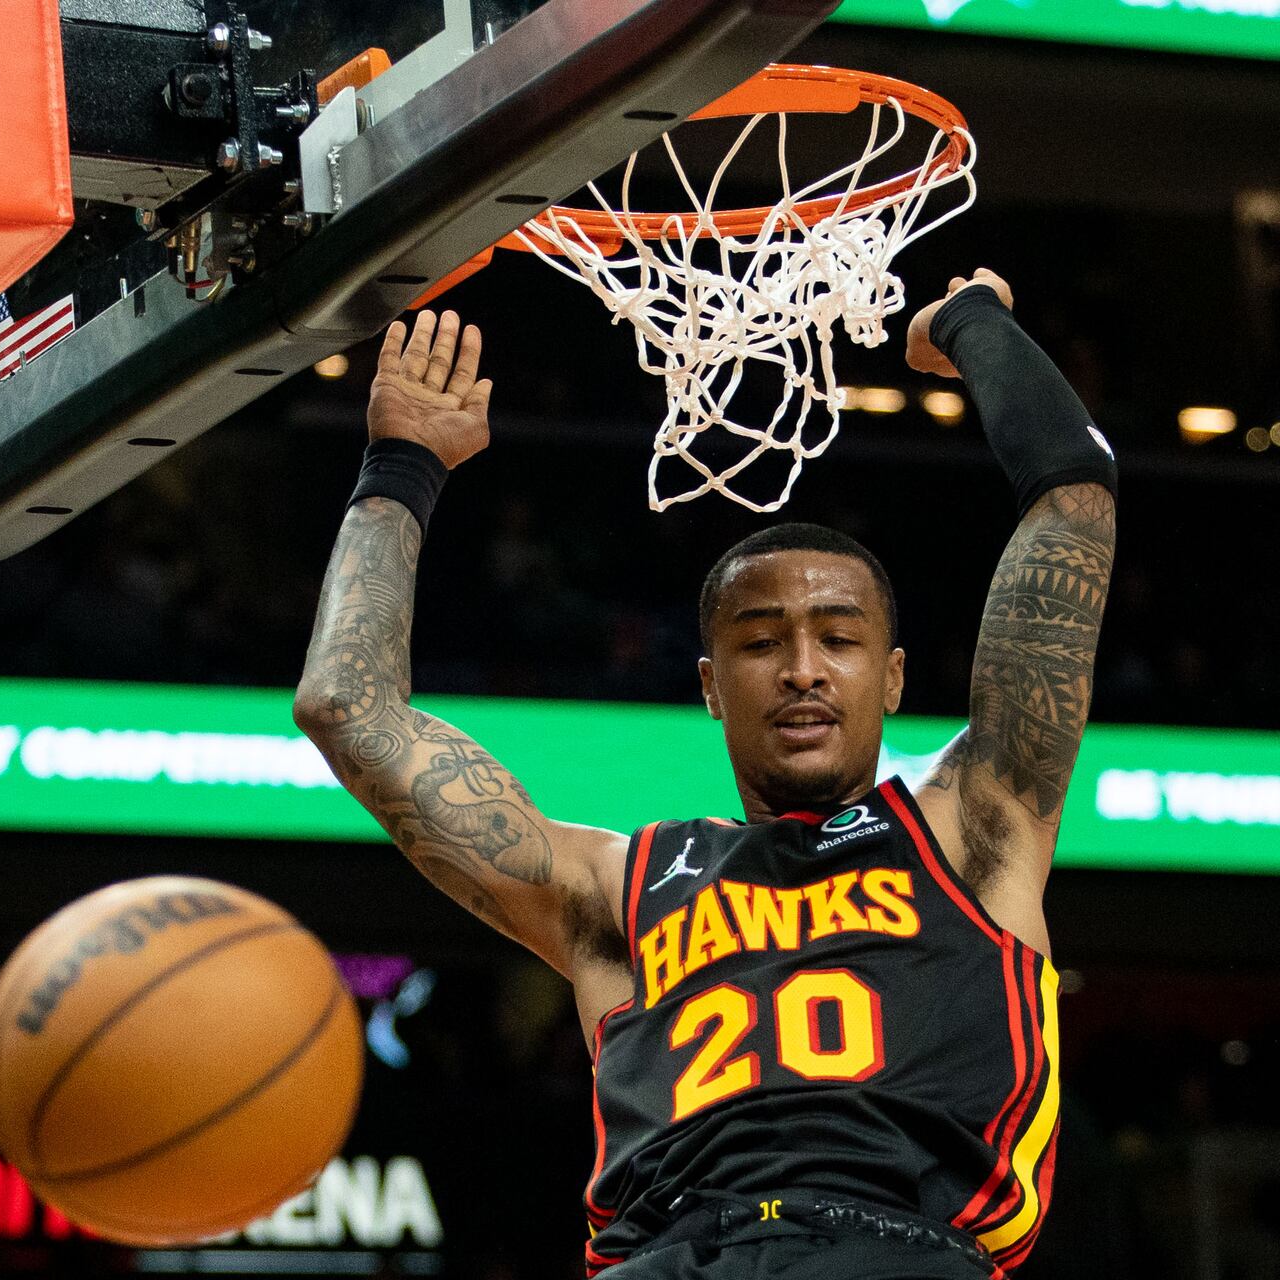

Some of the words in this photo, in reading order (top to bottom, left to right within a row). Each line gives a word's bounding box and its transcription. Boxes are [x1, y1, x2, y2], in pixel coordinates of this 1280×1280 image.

[816, 821, 890, 852] sharecare
[639, 868, 921, 1010] HAWKS
[668, 968, 886, 1124] 20
[198, 1155, 445, 1247] ENA
